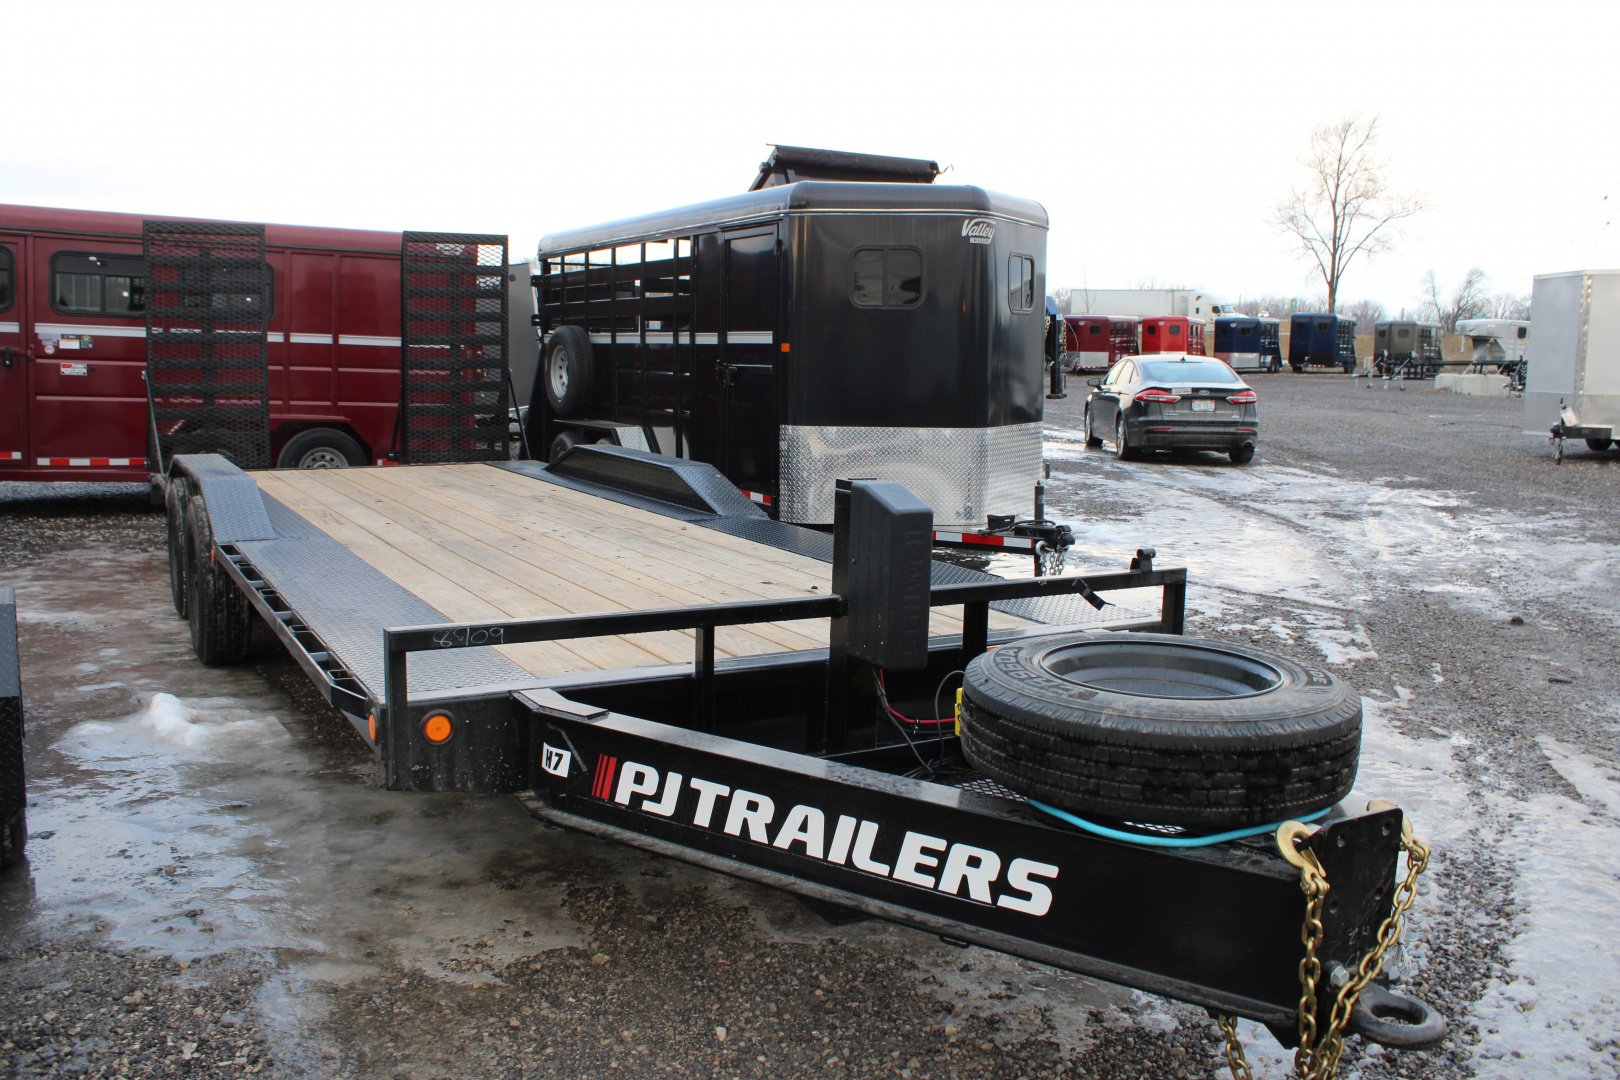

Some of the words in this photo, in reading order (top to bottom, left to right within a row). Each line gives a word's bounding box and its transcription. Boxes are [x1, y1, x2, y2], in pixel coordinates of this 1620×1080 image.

[961, 218, 996, 240] Valley
[545, 749, 564, 771] H7
[614, 761, 683, 817] PJ
[690, 777, 1060, 917] TRAILERS
